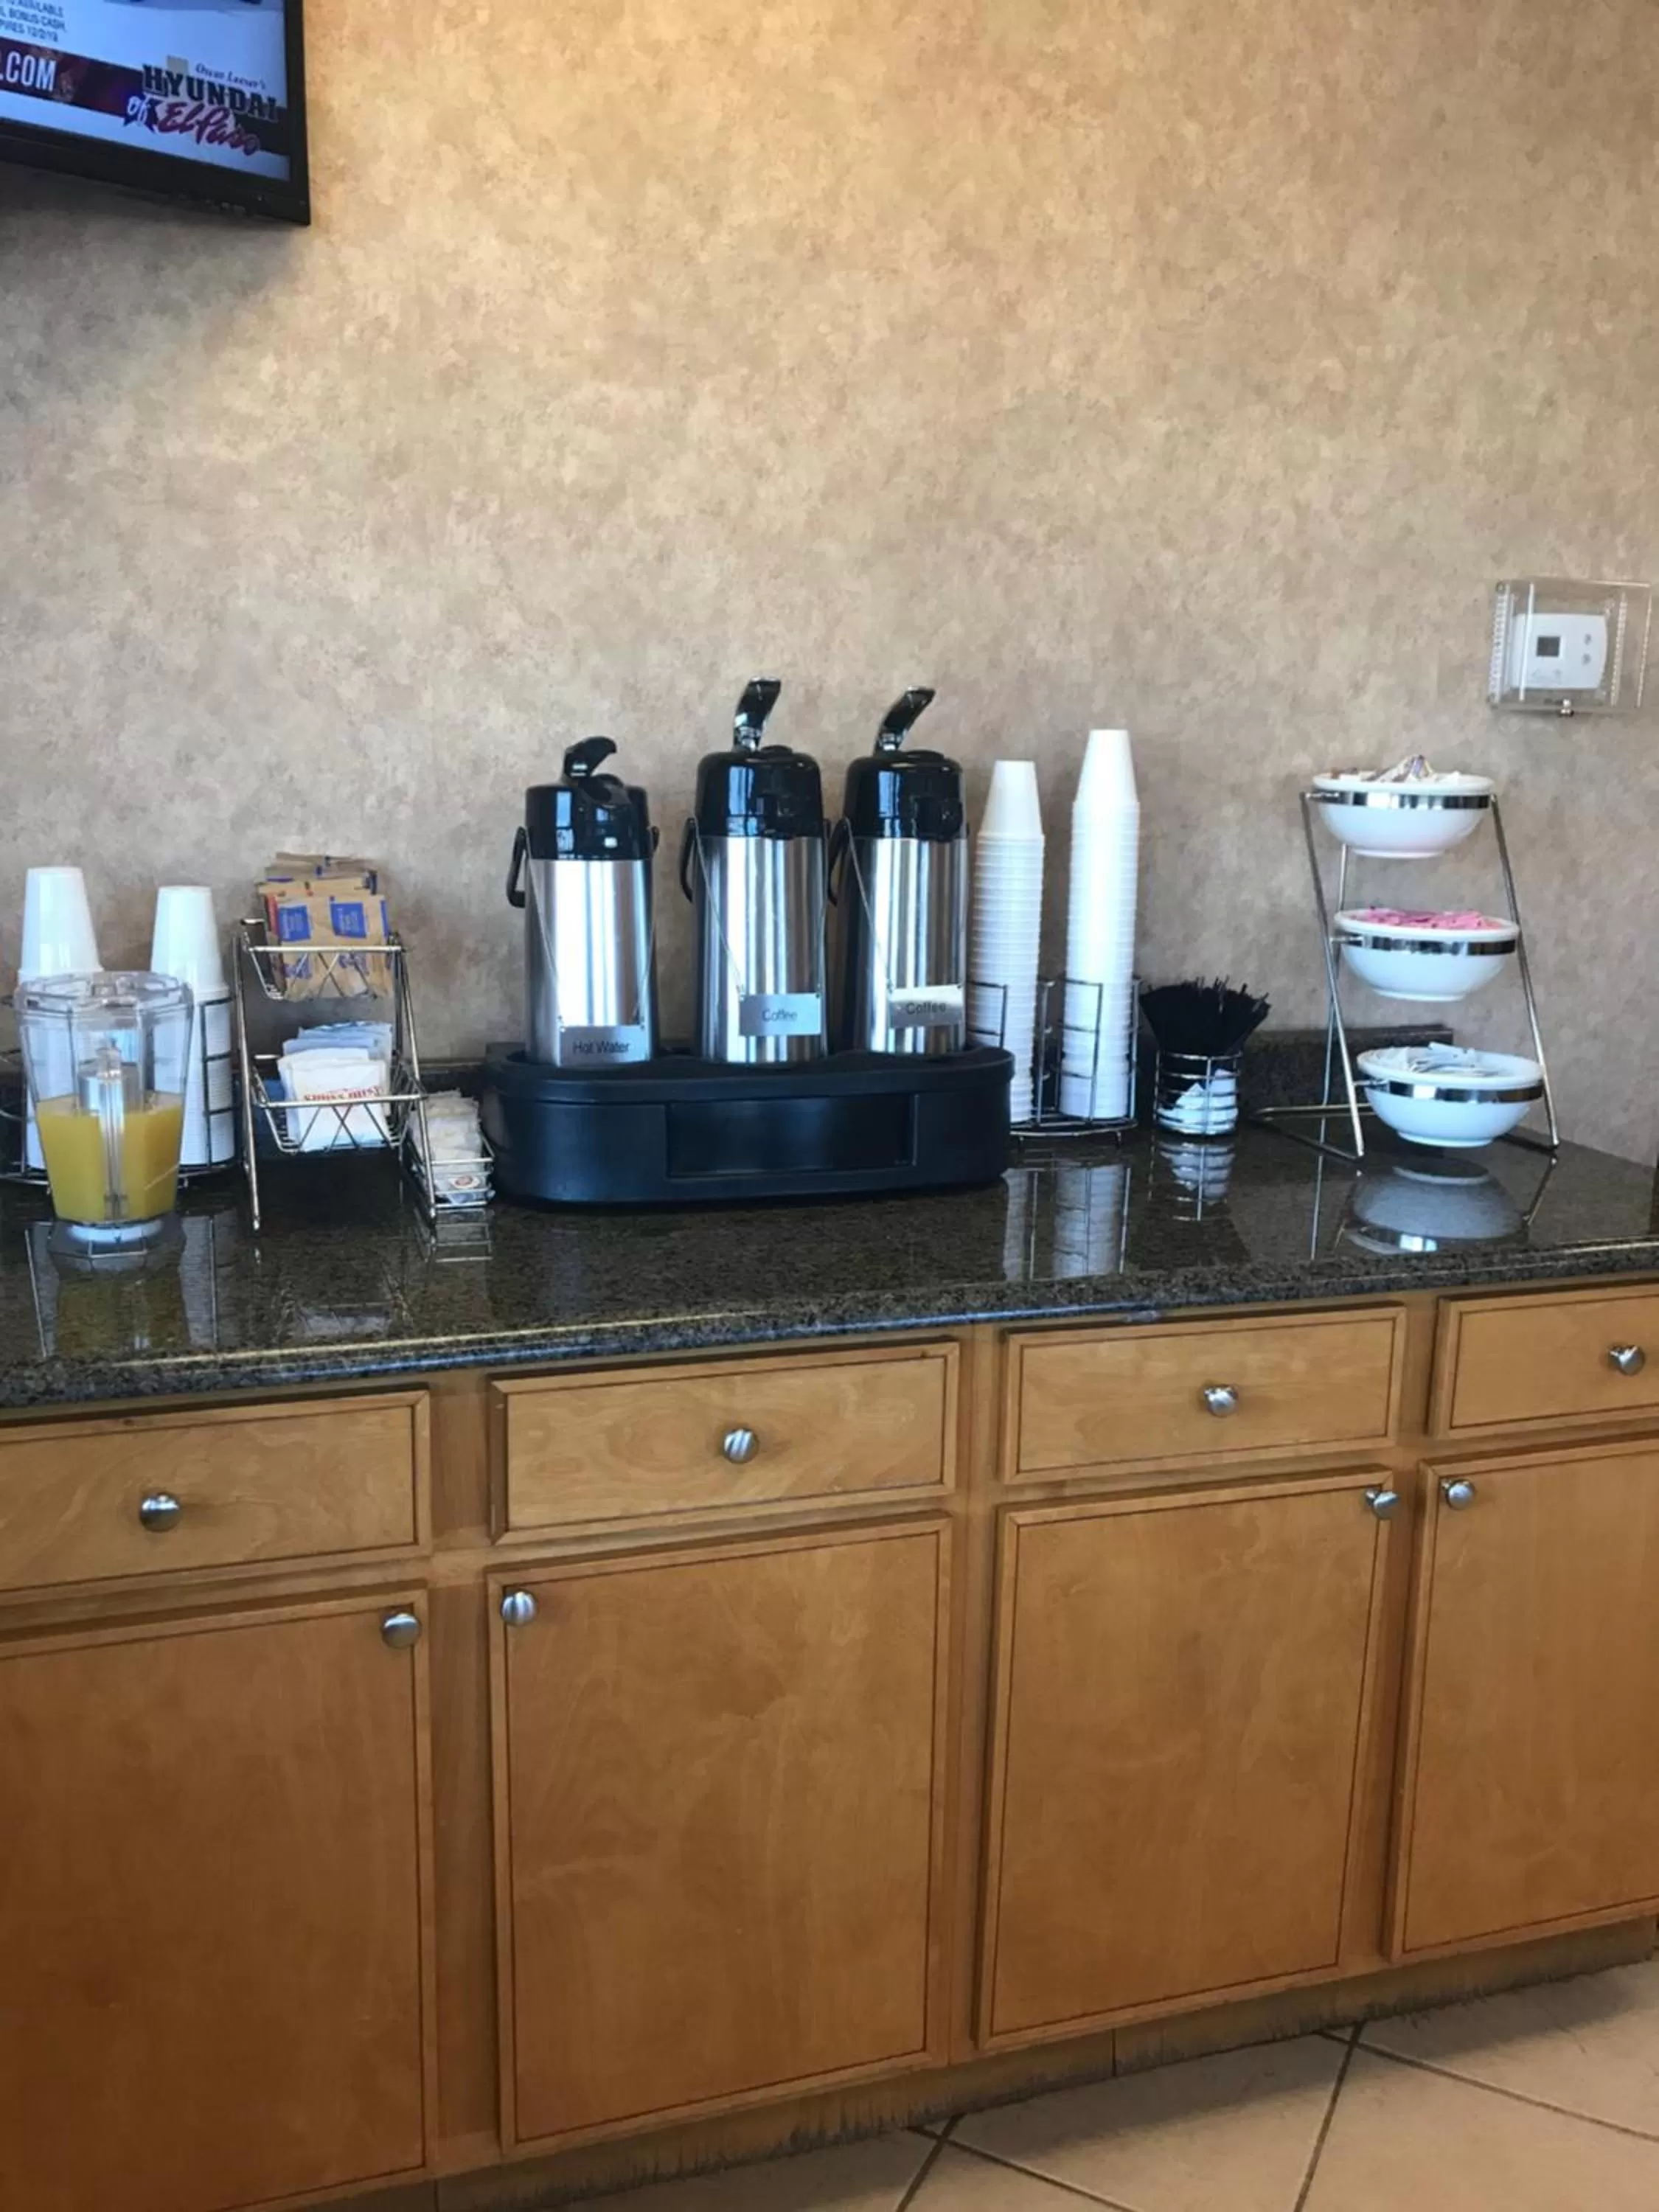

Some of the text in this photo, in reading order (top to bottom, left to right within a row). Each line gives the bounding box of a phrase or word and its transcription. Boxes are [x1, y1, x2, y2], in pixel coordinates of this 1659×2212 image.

[142, 64, 279, 122] HYUNDAI
[905, 1000, 947, 1015] Coffee
[762, 1008, 798, 1023] Coffee
[572, 1040, 630, 1054] Hot Water
